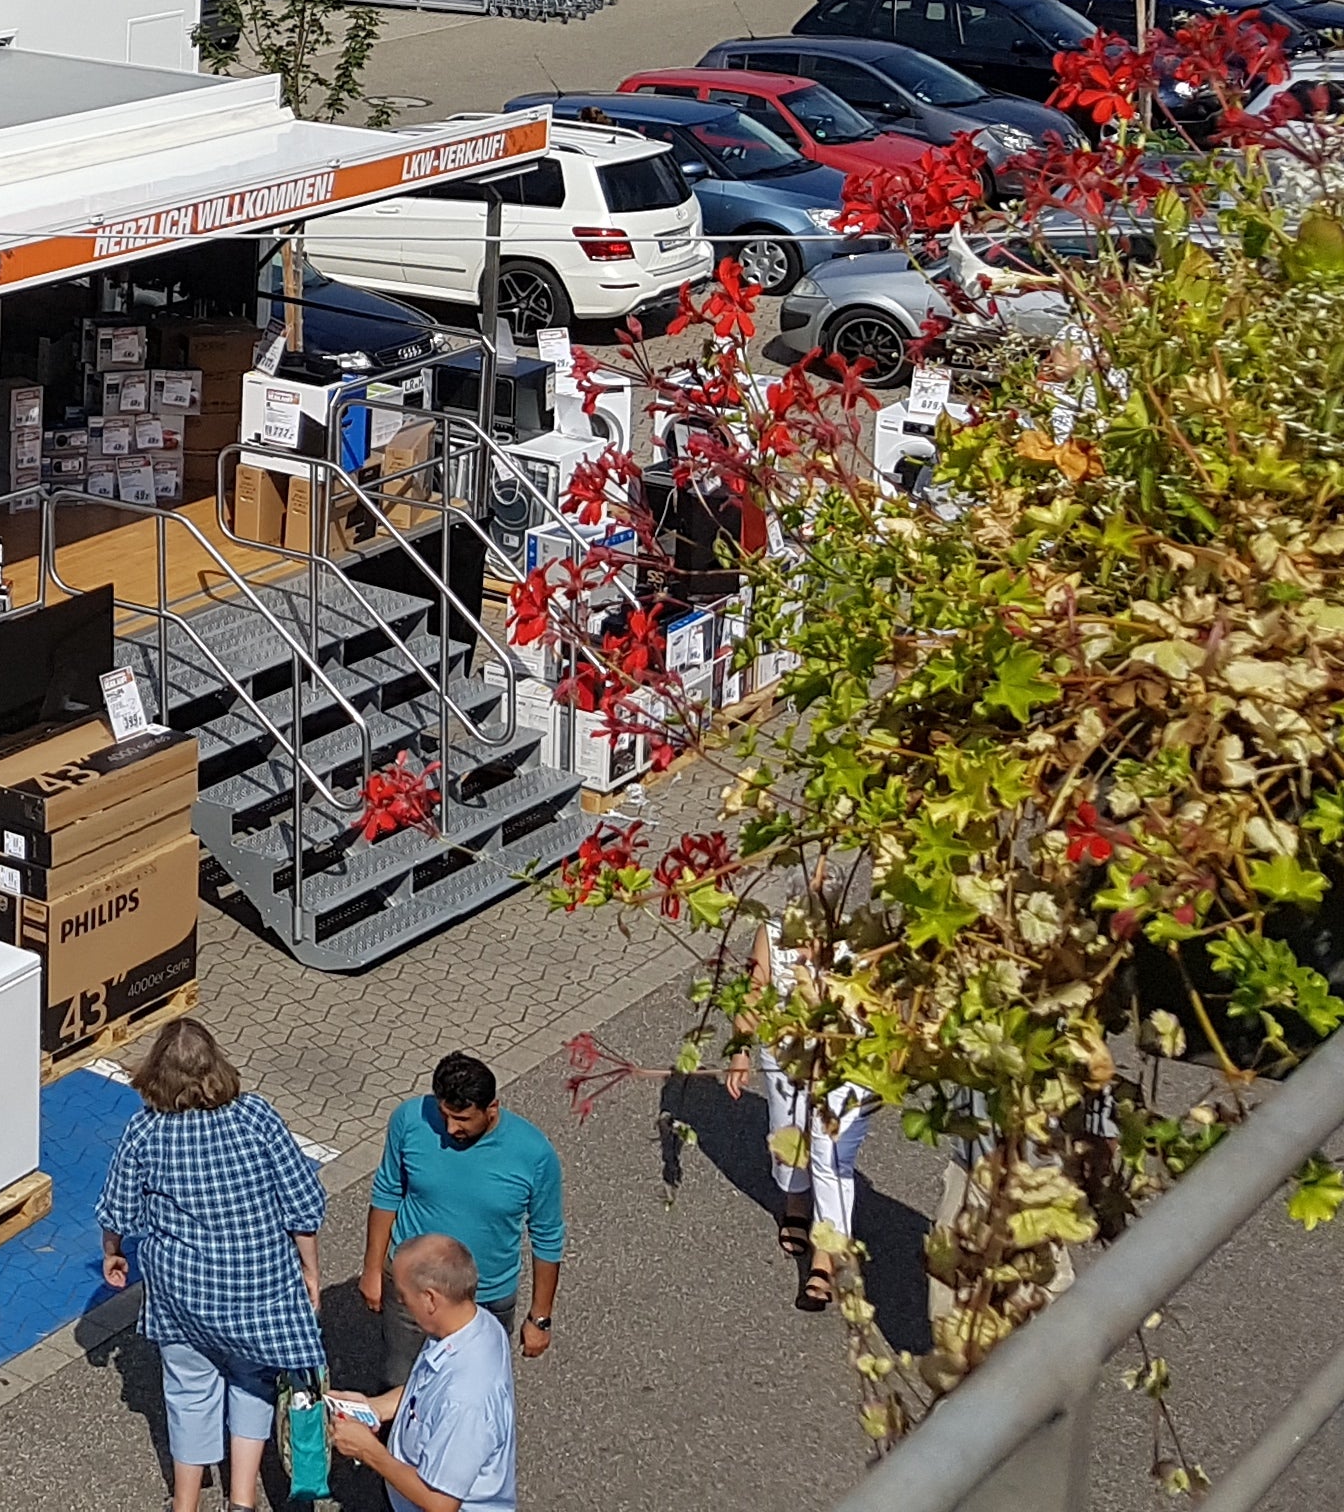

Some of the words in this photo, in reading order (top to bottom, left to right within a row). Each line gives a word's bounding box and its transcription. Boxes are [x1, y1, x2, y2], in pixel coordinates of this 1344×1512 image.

[400, 134, 506, 182] LKW-VERKAUF!
[93, 203, 196, 258] HERZLICH
[198, 172, 334, 235] WILLKOMMEN!
[60, 888, 140, 944] PHILIPS
[128, 970, 165, 998] 4000er
[166, 957, 191, 979] Serie
